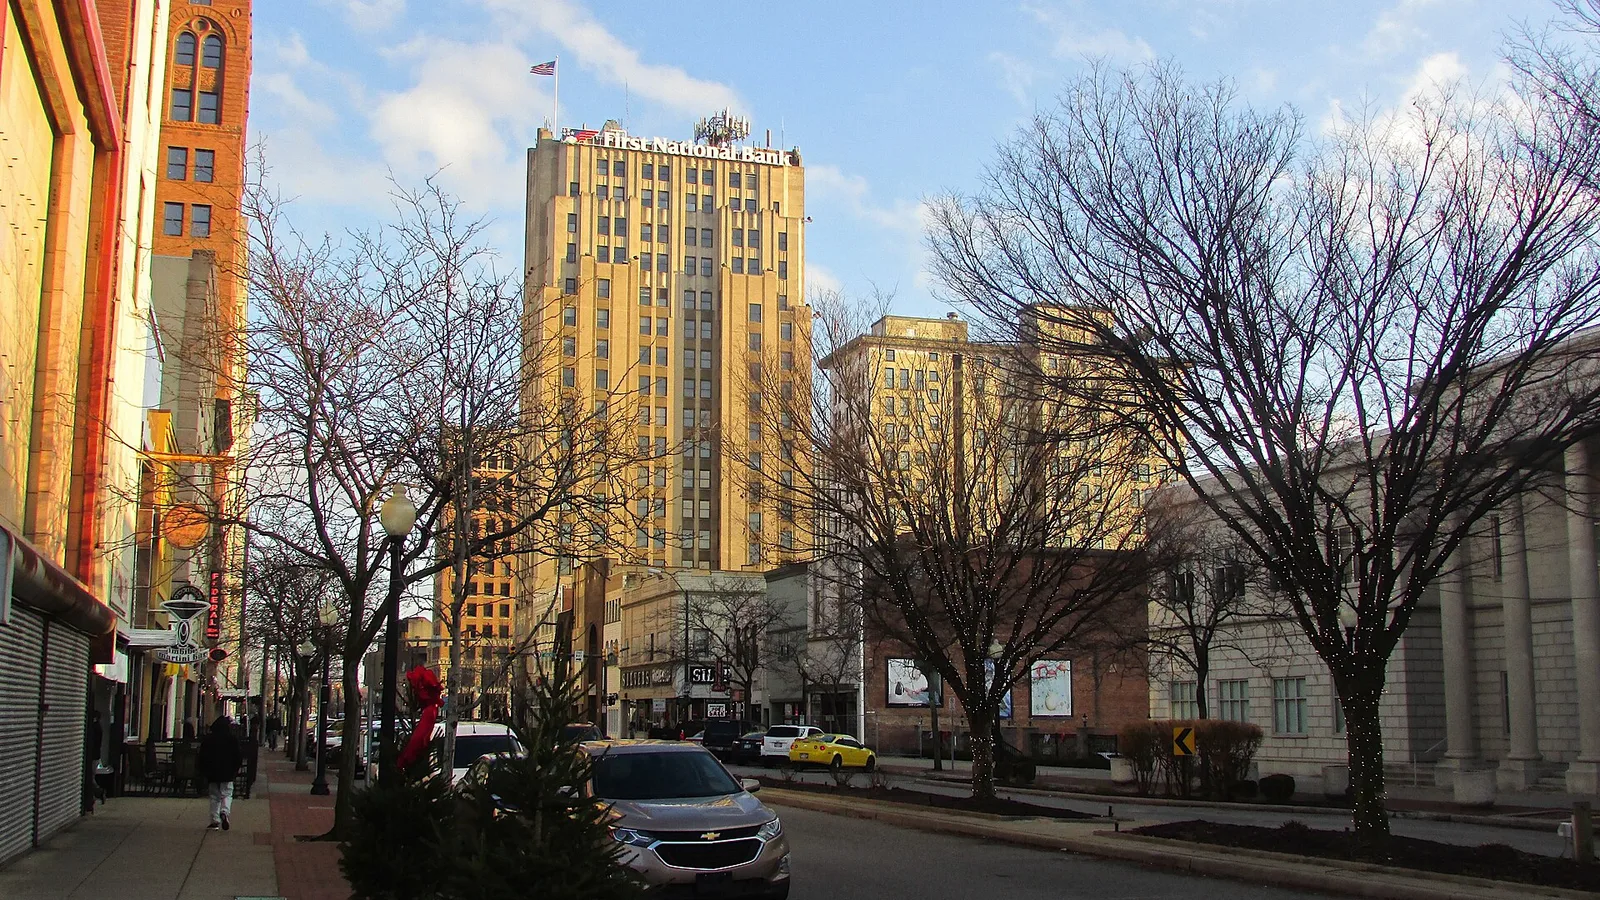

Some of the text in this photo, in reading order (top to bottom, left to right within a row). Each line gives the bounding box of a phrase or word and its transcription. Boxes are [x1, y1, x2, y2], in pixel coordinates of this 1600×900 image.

[604, 131, 792, 166] First National Bank
[158, 651, 208, 661] martini bar
